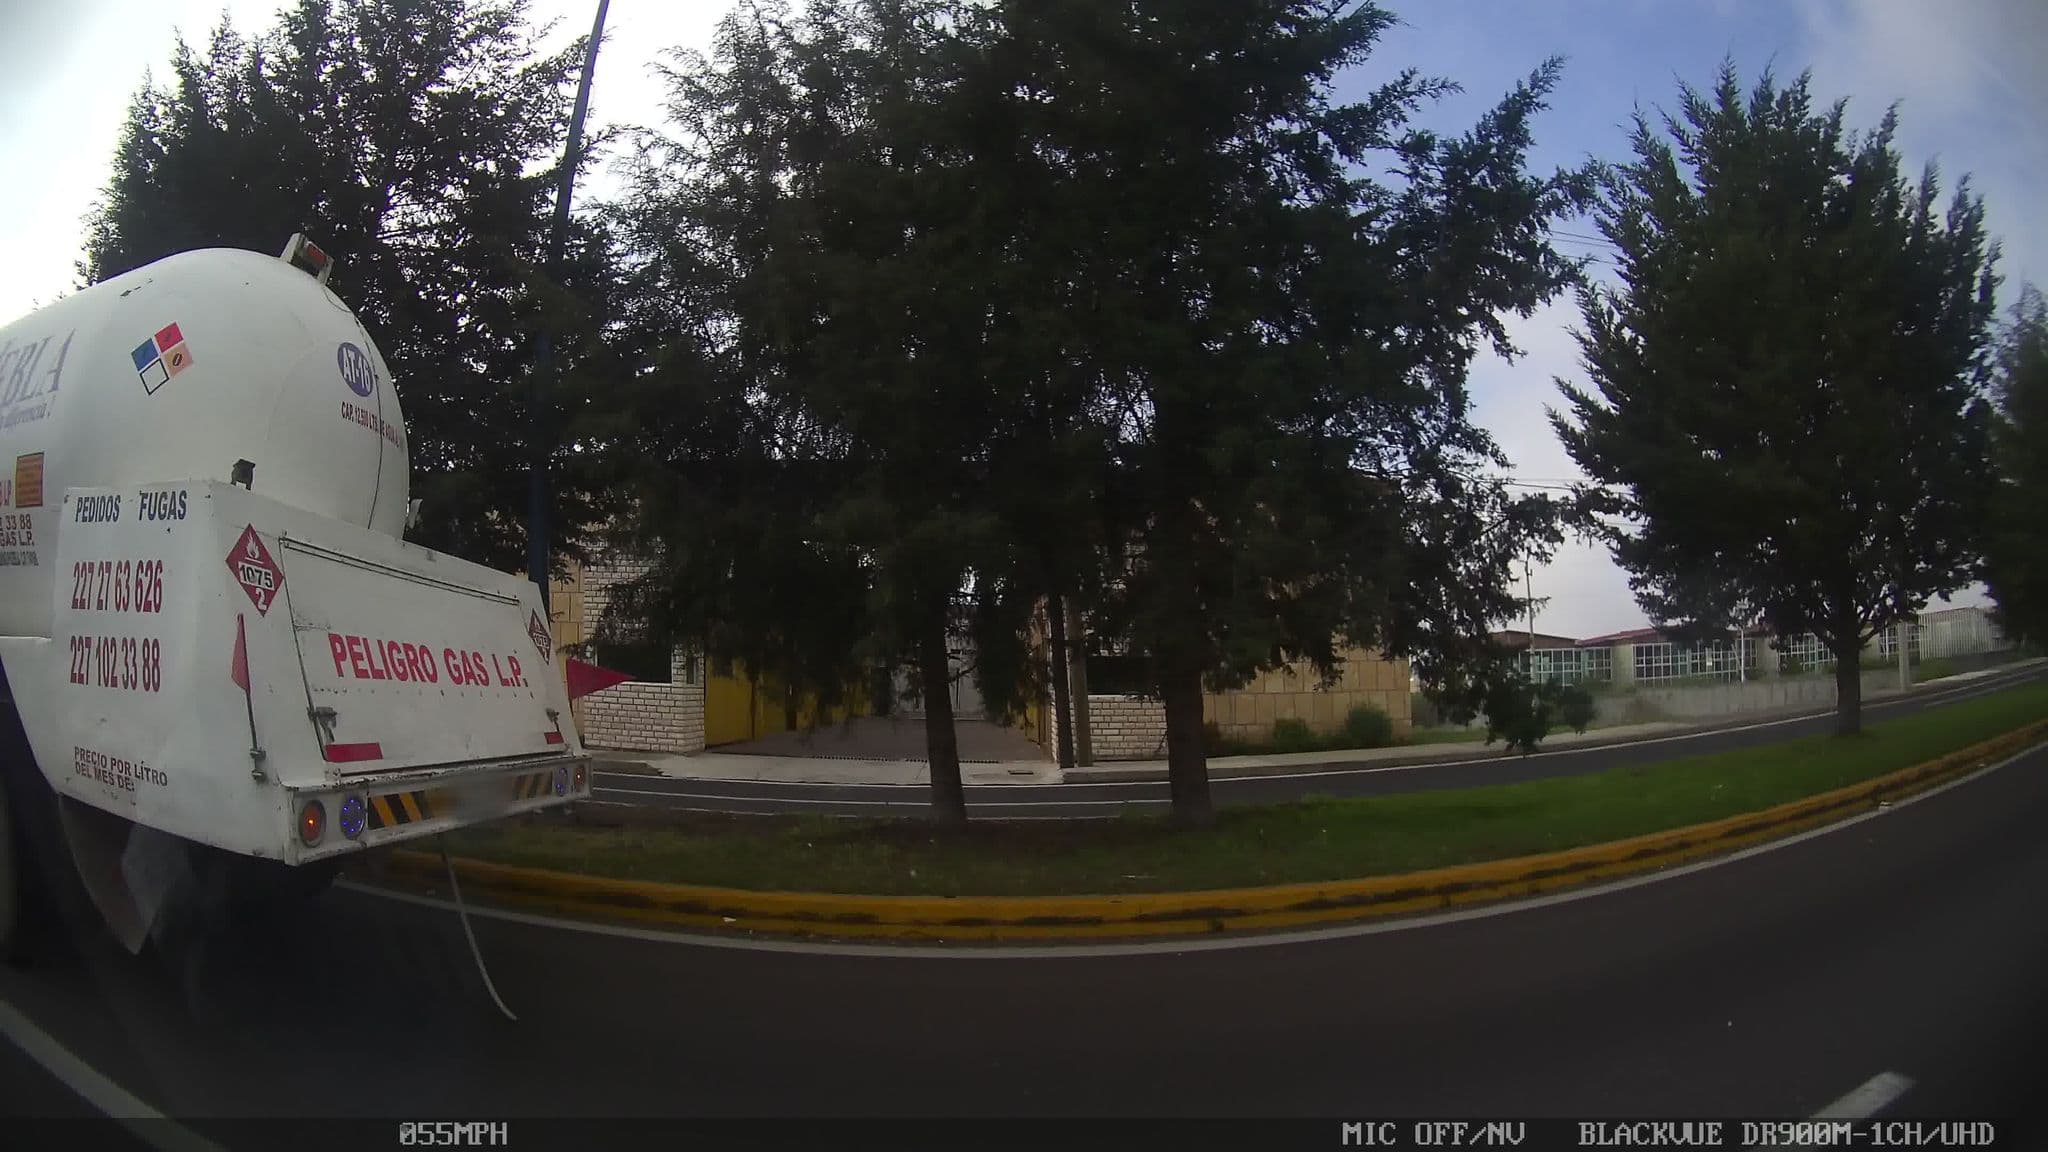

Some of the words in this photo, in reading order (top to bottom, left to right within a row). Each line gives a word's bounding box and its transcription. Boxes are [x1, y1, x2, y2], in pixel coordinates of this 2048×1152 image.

[343, 346, 371, 393] AT-16
[341, 401, 354, 423] CAP.
[75, 494, 121, 523] PEDIDOS
[139, 490, 187, 521] FUGAS
[71, 561, 95, 610] 227
[97, 561, 112, 611] 27
[115, 559, 130, 612] 63
[135, 559, 163, 613] 626
[239, 564, 274, 589] 1075
[256, 587, 267, 611] 2
[70, 635, 92, 686] 227
[96, 636, 118, 688] 102
[121, 637, 138, 690] 33
[142, 637, 161, 692] 88
[328, 633, 439, 683] PELIGRO
[443, 648, 490, 687] GAS
[492, 653, 528, 688] L.P.
[74, 746, 107, 769] PRECIO
[110, 757, 131, 776] POR
[75, 761, 92, 778] DEL
[94, 766, 115, 786] MES
